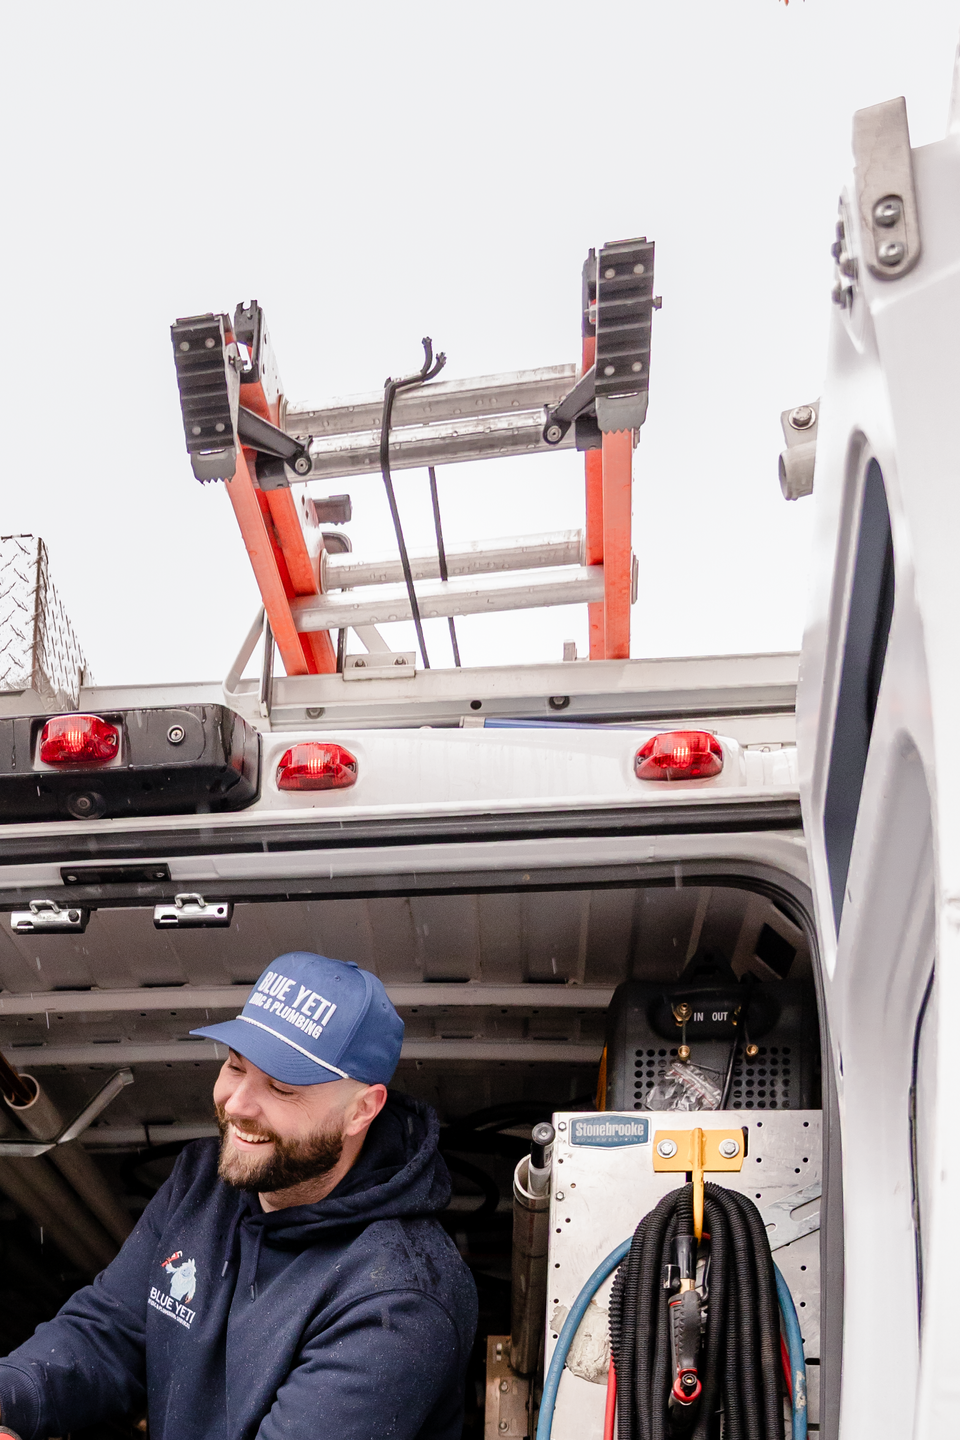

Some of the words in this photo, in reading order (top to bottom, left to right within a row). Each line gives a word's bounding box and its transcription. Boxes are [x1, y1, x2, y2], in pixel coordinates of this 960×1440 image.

[257, 971, 297, 1002] BLUE
[291, 984, 337, 1027] YETI
[693, 1012, 704, 1022] IN
[711, 1011, 729, 1022] OUT
[262, 998, 273, 1010] &
[269, 1000, 323, 1040] PLUMBING
[575, 1121, 645, 1137] Stonebrooke
[150, 1286, 175, 1310] BLUE
[176, 1301, 196, 1324] YETI
